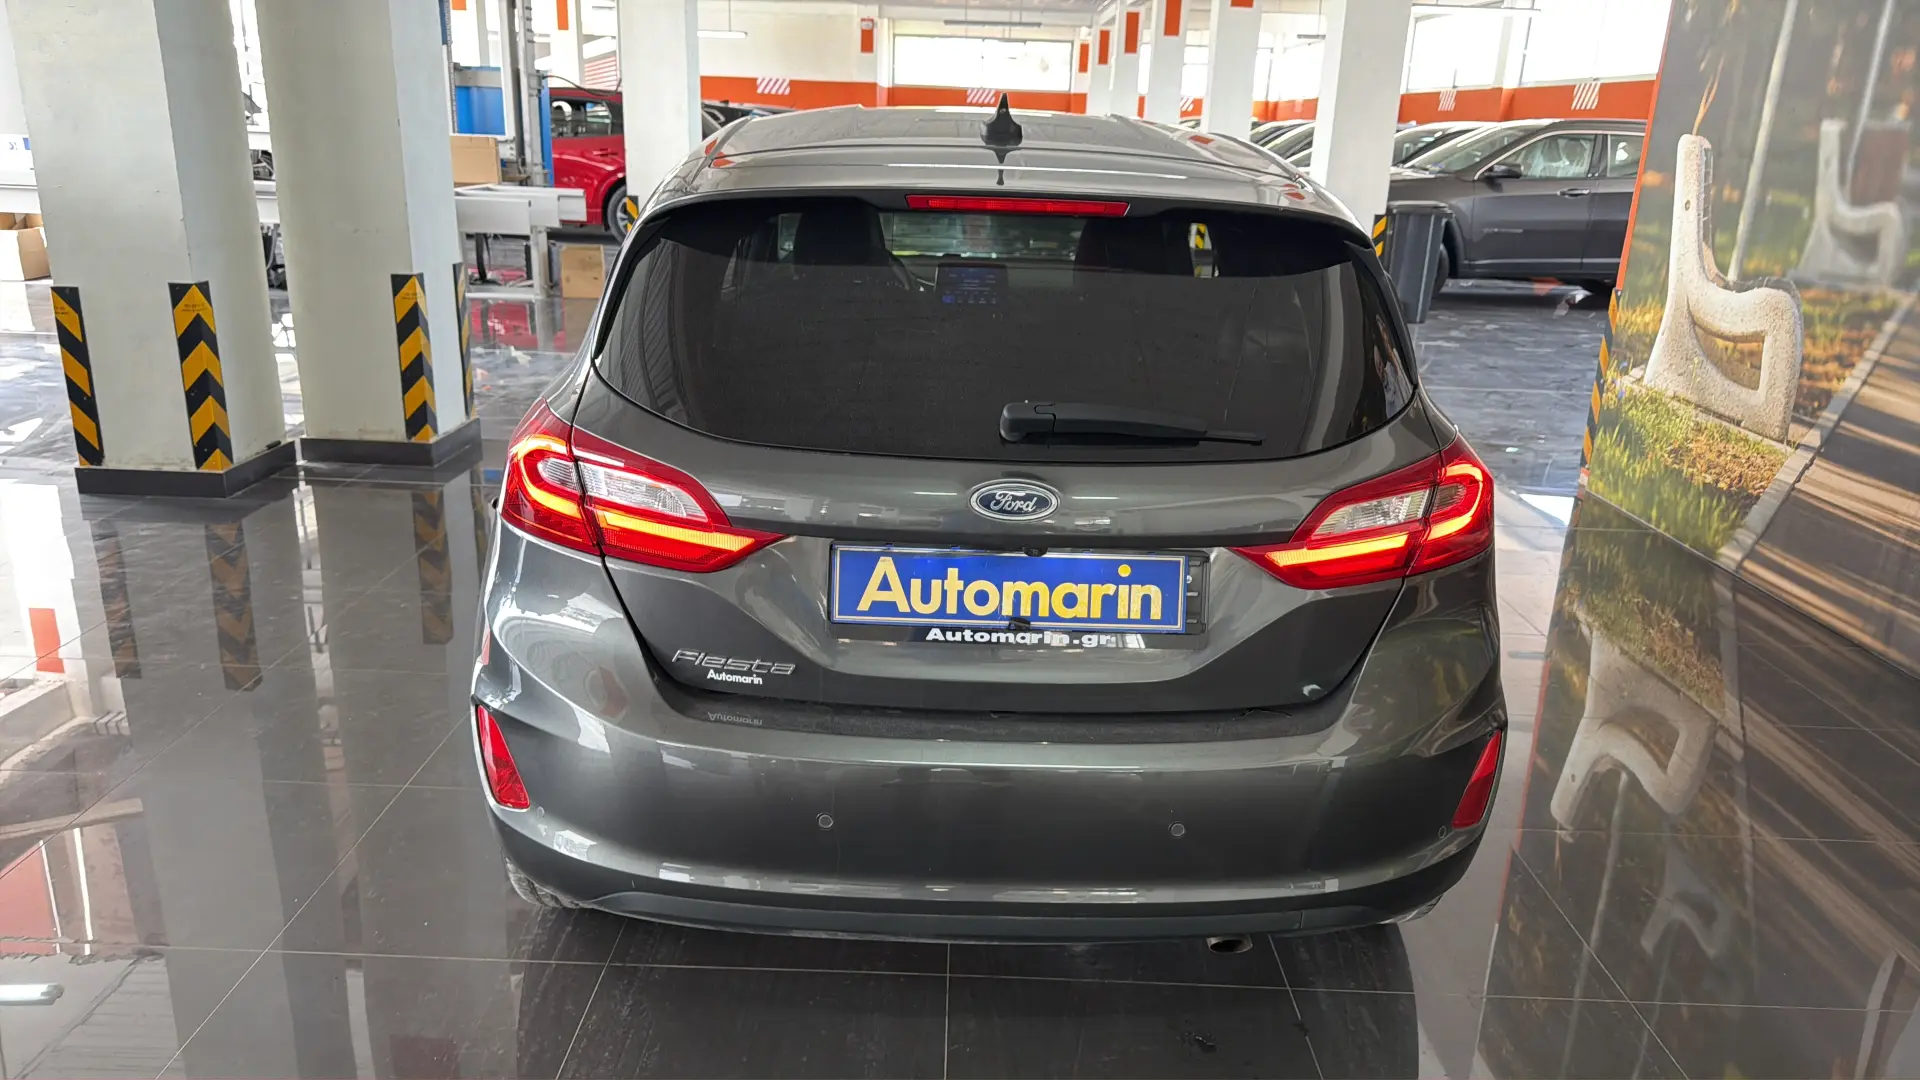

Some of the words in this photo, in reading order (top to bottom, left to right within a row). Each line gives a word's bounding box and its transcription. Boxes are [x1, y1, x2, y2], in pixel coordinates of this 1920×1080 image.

[990, 491, 1037, 512] Ford
[857, 556, 1162, 620] Automarin
[925, 627, 1114, 648] Automarin.gr
[672, 649, 796, 675] Fiesta
[707, 669, 763, 685] Automarin
